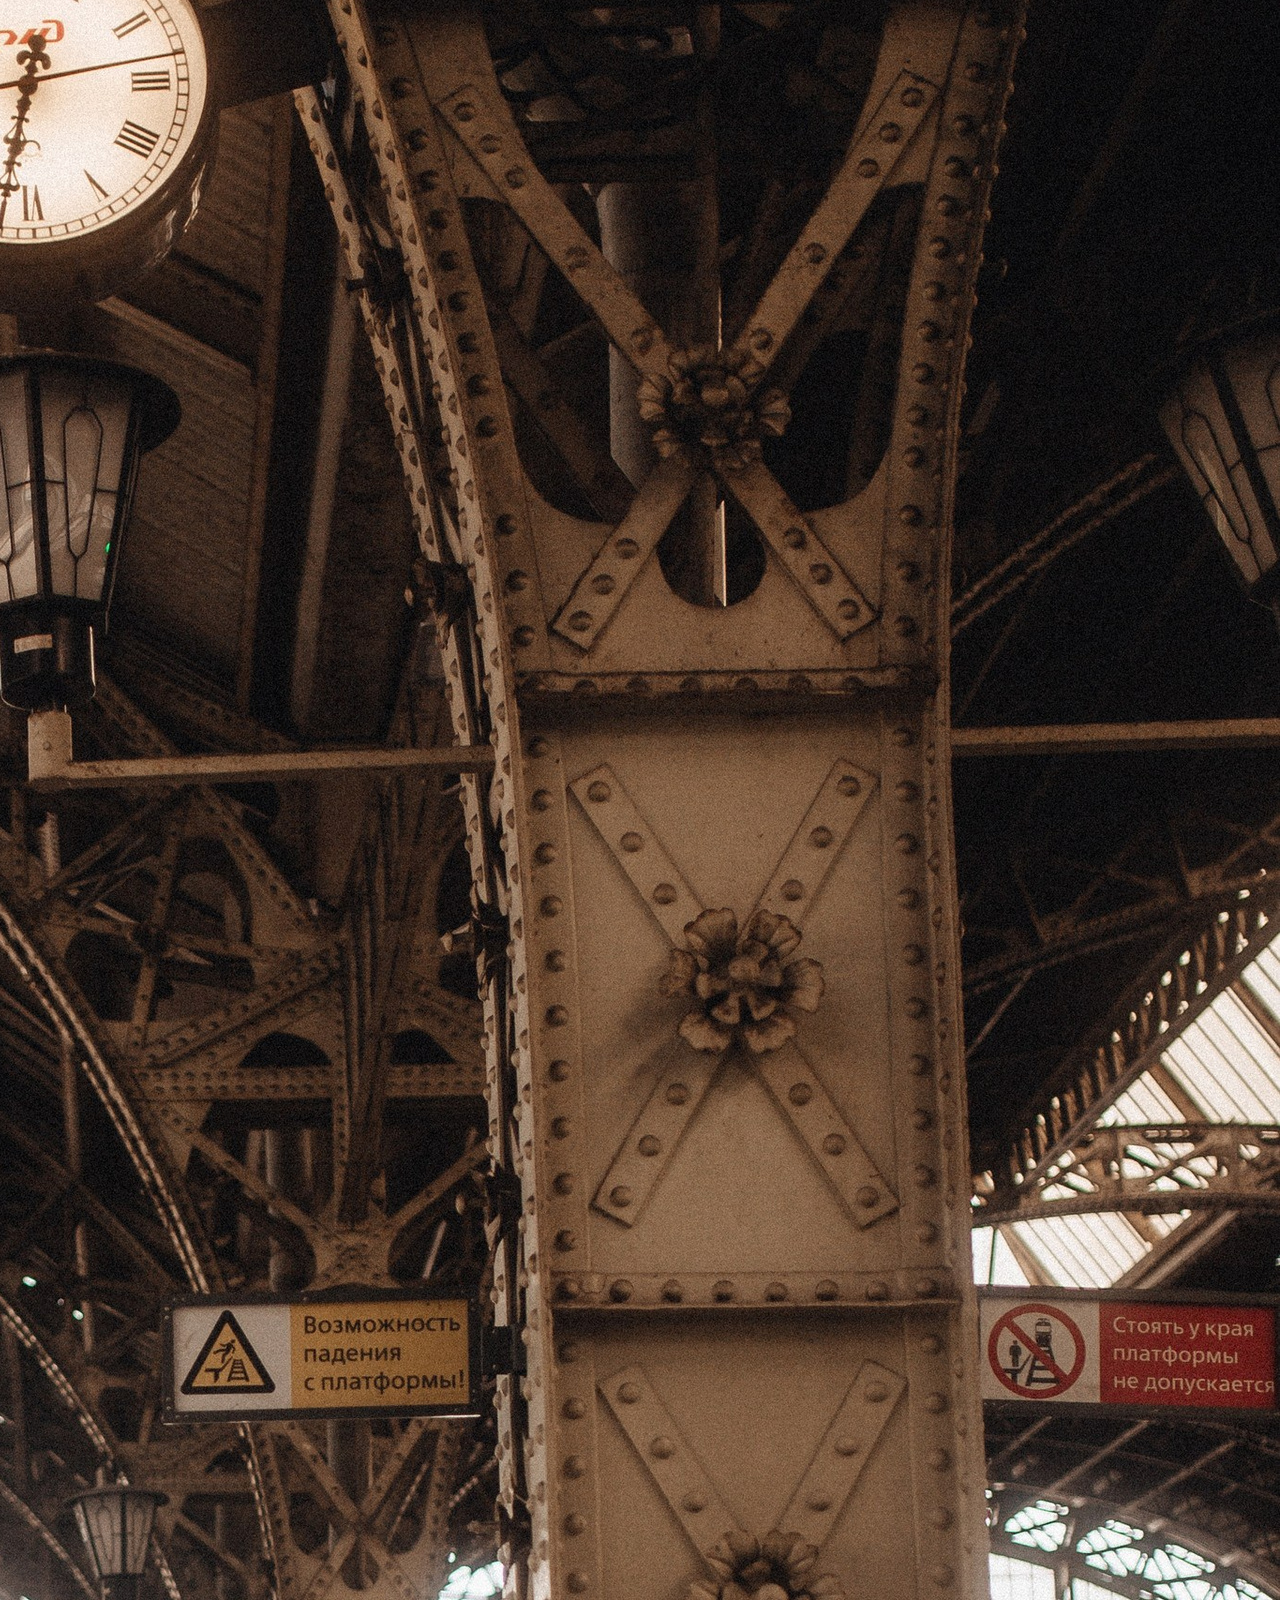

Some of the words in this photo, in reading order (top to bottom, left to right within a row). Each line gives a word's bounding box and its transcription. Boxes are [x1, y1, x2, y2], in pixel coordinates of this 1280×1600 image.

[131, 70, 170, 92] III
[304, 1315, 461, 1334] Возможность
[1113, 1316, 1184, 1335] Стоять
[1189, 1322, 1201, 1340] у
[1205, 1322, 1254, 1340] края
[304, 1346, 401, 1365] падения
[1113, 1346, 1239, 1367] платформы
[304, 1376, 314, 1390] с
[321, 1369, 465, 1394] платформы!
[1113, 1376, 1139, 1389] не
[1144, 1376, 1275, 1395] допускается
